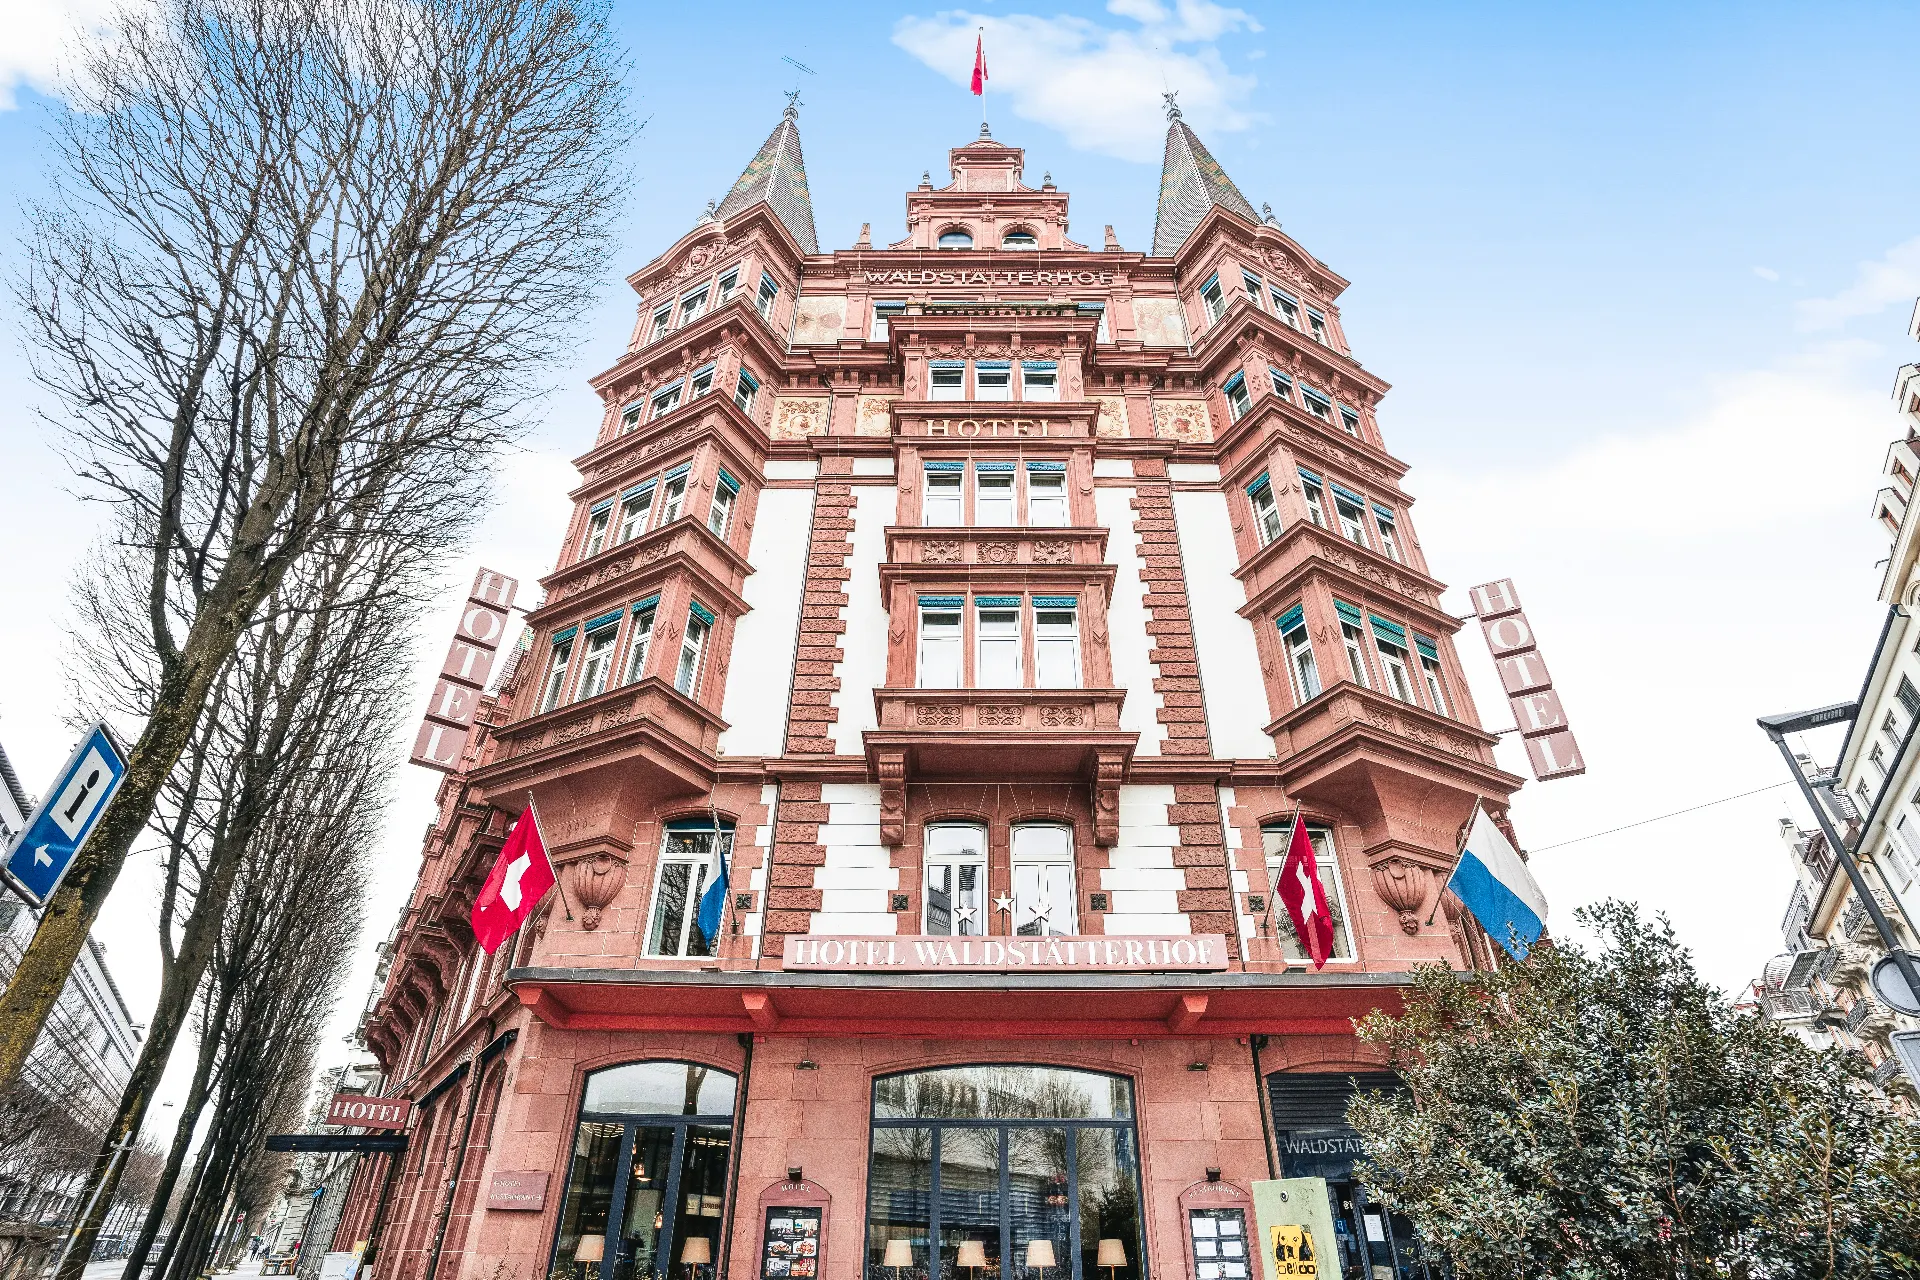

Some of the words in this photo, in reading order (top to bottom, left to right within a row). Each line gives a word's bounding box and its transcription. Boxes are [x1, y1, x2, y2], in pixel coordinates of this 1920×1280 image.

[926, 419, 1061, 437] HOTEL
[422, 570, 514, 764] HOTEL
[1475, 580, 1577, 773] HOTEL
[794, 940, 905, 966] HOTEL
[912, 938, 1215, 966] WALDSTÄTTERHOF
[332, 1101, 405, 1123] HOTEL
